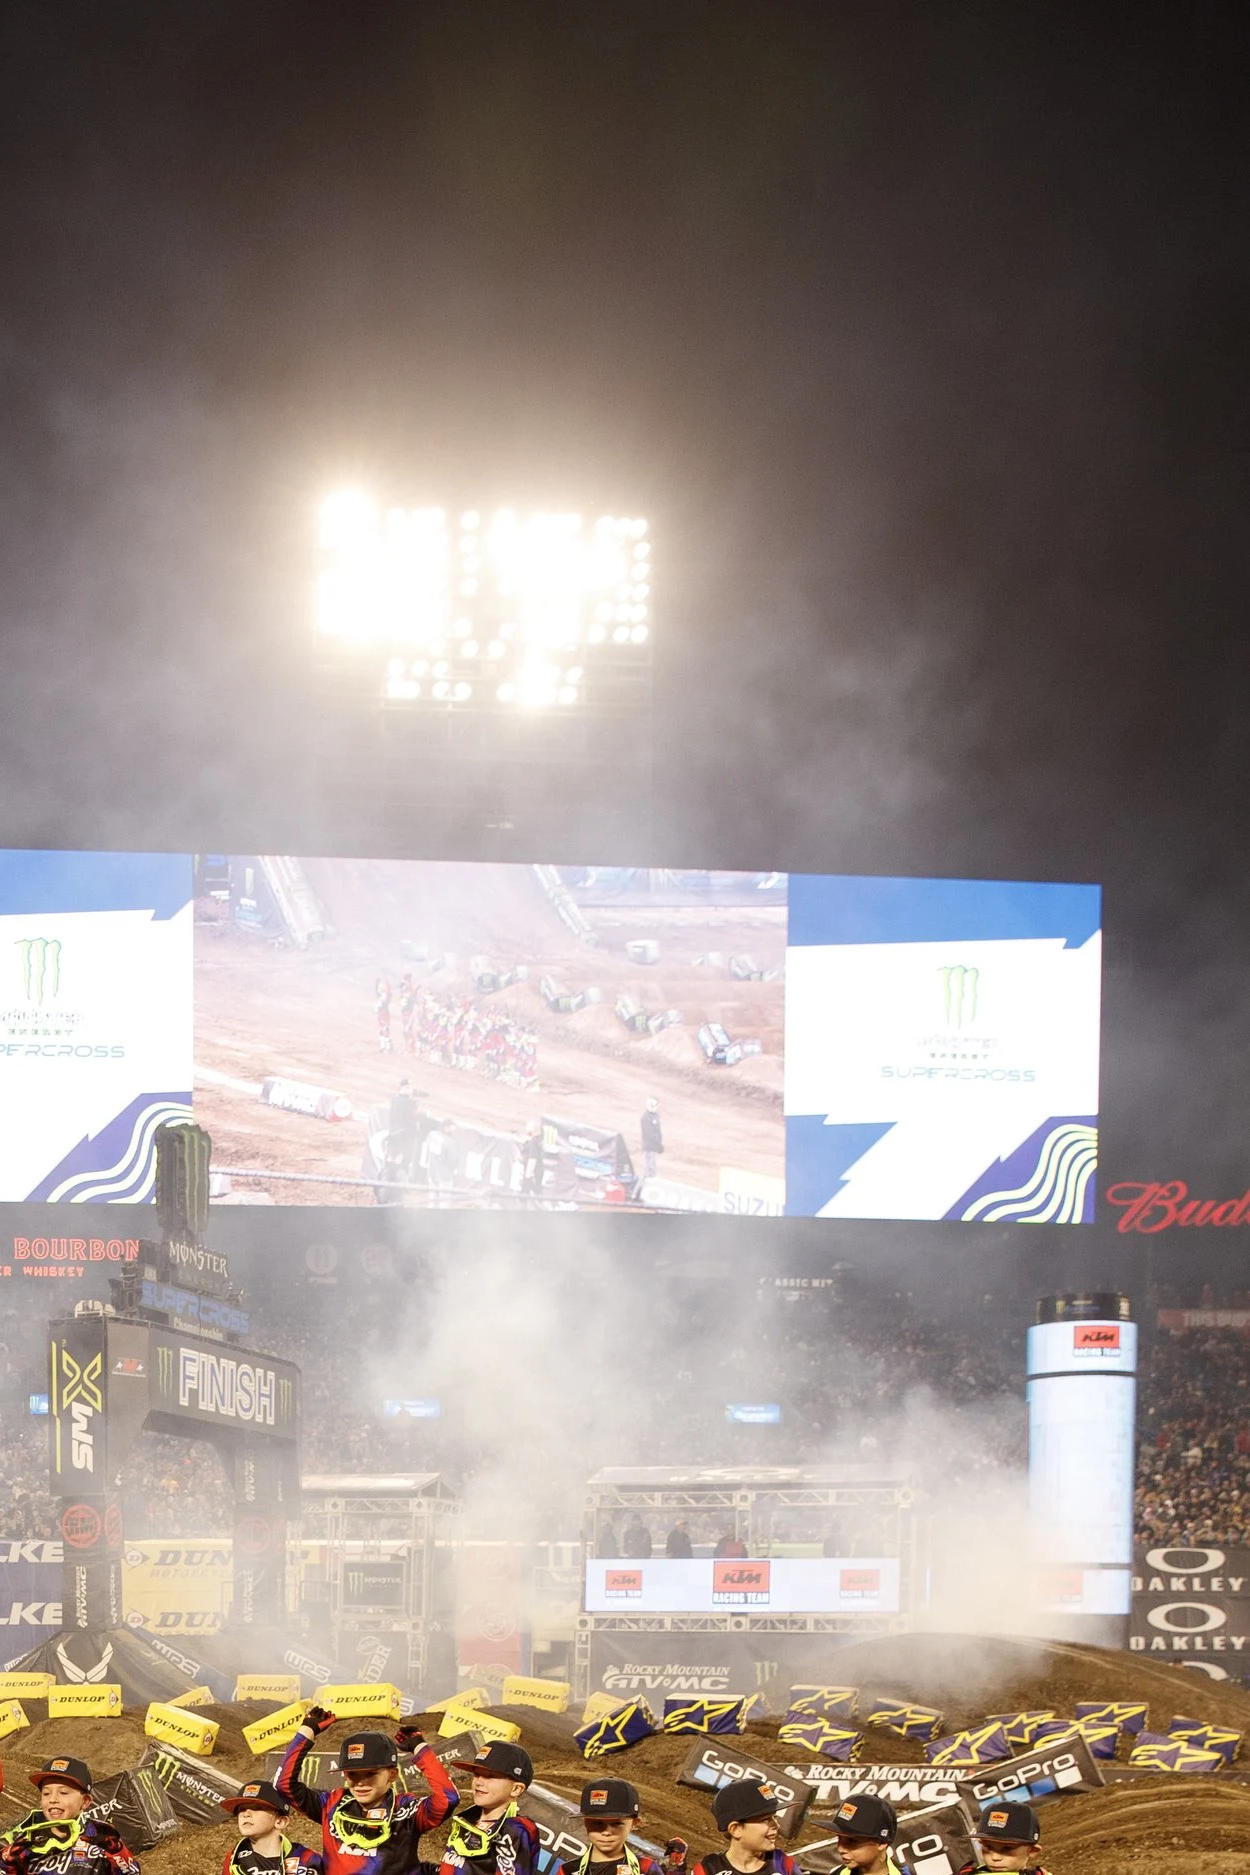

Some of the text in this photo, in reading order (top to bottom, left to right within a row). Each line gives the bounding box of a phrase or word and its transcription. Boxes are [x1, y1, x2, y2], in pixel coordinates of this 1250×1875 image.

[1105, 1180, 1250, 1233] Bud
[14, 1238, 141, 1261] BOURBON
[169, 1240, 229, 1279] MONSTER
[23, 1266, 85, 1277] WHISKEY
[1082, 1332, 1115, 1342] KTM
[179, 1347, 275, 1425] FINISH
[154, 1550, 232, 1566] DUN
[722, 1569, 762, 1584] KTM
[1131, 1577, 1244, 1592] OAKLEY
[713, 1592, 769, 1604] RACING TEAM
[1129, 1636, 1246, 1650] OAKLEY
[285, 1651, 331, 1683] WPS
[623, 1663, 730, 1676] ROCKY MOUNTAIN
[5, 1680, 44, 1688] DUNLOP
[59, 1695, 105, 1703] DUNLOP
[335, 1694, 386, 1704] DUNLOP
[514, 1689, 559, 1701] DUNLOP
[154, 1717, 200, 1740] DUNLOP
[259, 1713, 303, 1740] DUNLOP
[454, 1716, 507, 1739] DUNLOP
[809, 1764, 967, 1782] ROCKY MOUNTAIN
[972, 1752, 1078, 1800] GoPro
